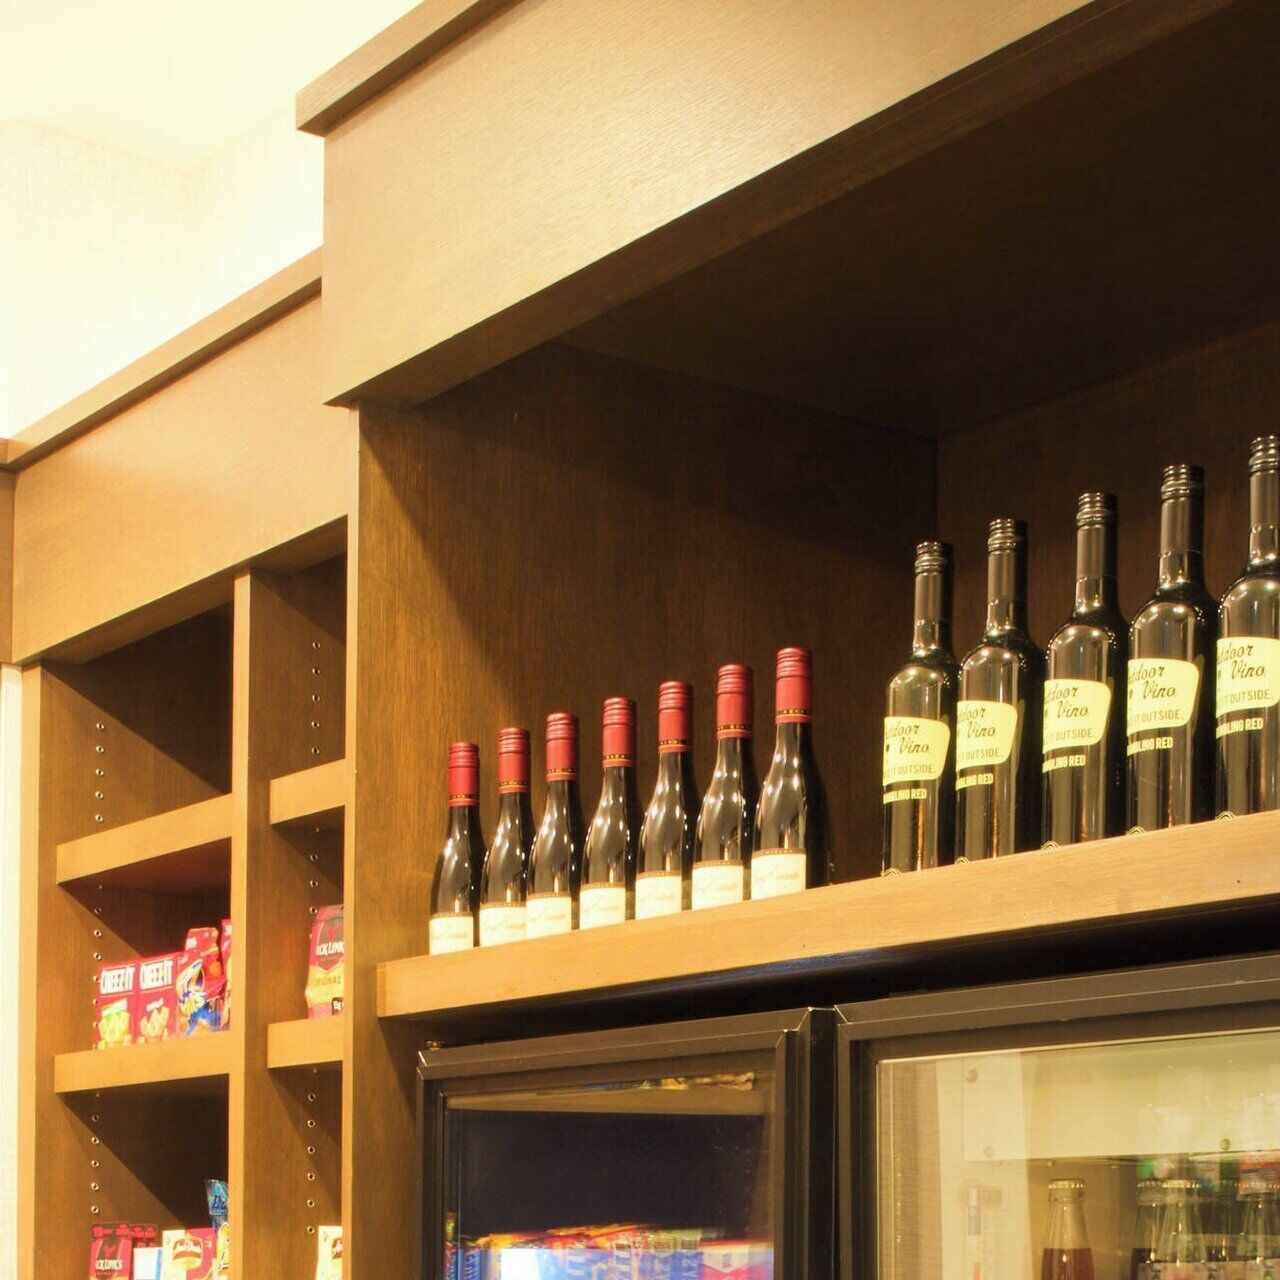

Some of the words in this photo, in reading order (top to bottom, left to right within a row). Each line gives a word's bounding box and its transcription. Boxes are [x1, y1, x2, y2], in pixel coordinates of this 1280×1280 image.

[1231, 660, 1265, 679] Vino
[1142, 681, 1176, 699] Vino
[1057, 700, 1088, 719] Vino
[967, 721, 996, 738] Vino
[1246, 717, 1264, 731] RED
[899, 737, 929, 753] Vino
[1155, 737, 1173, 749] RED
[1068, 755, 1086, 766] RED
[978, 773, 994, 785] RED
[911, 788, 927, 799] RED
